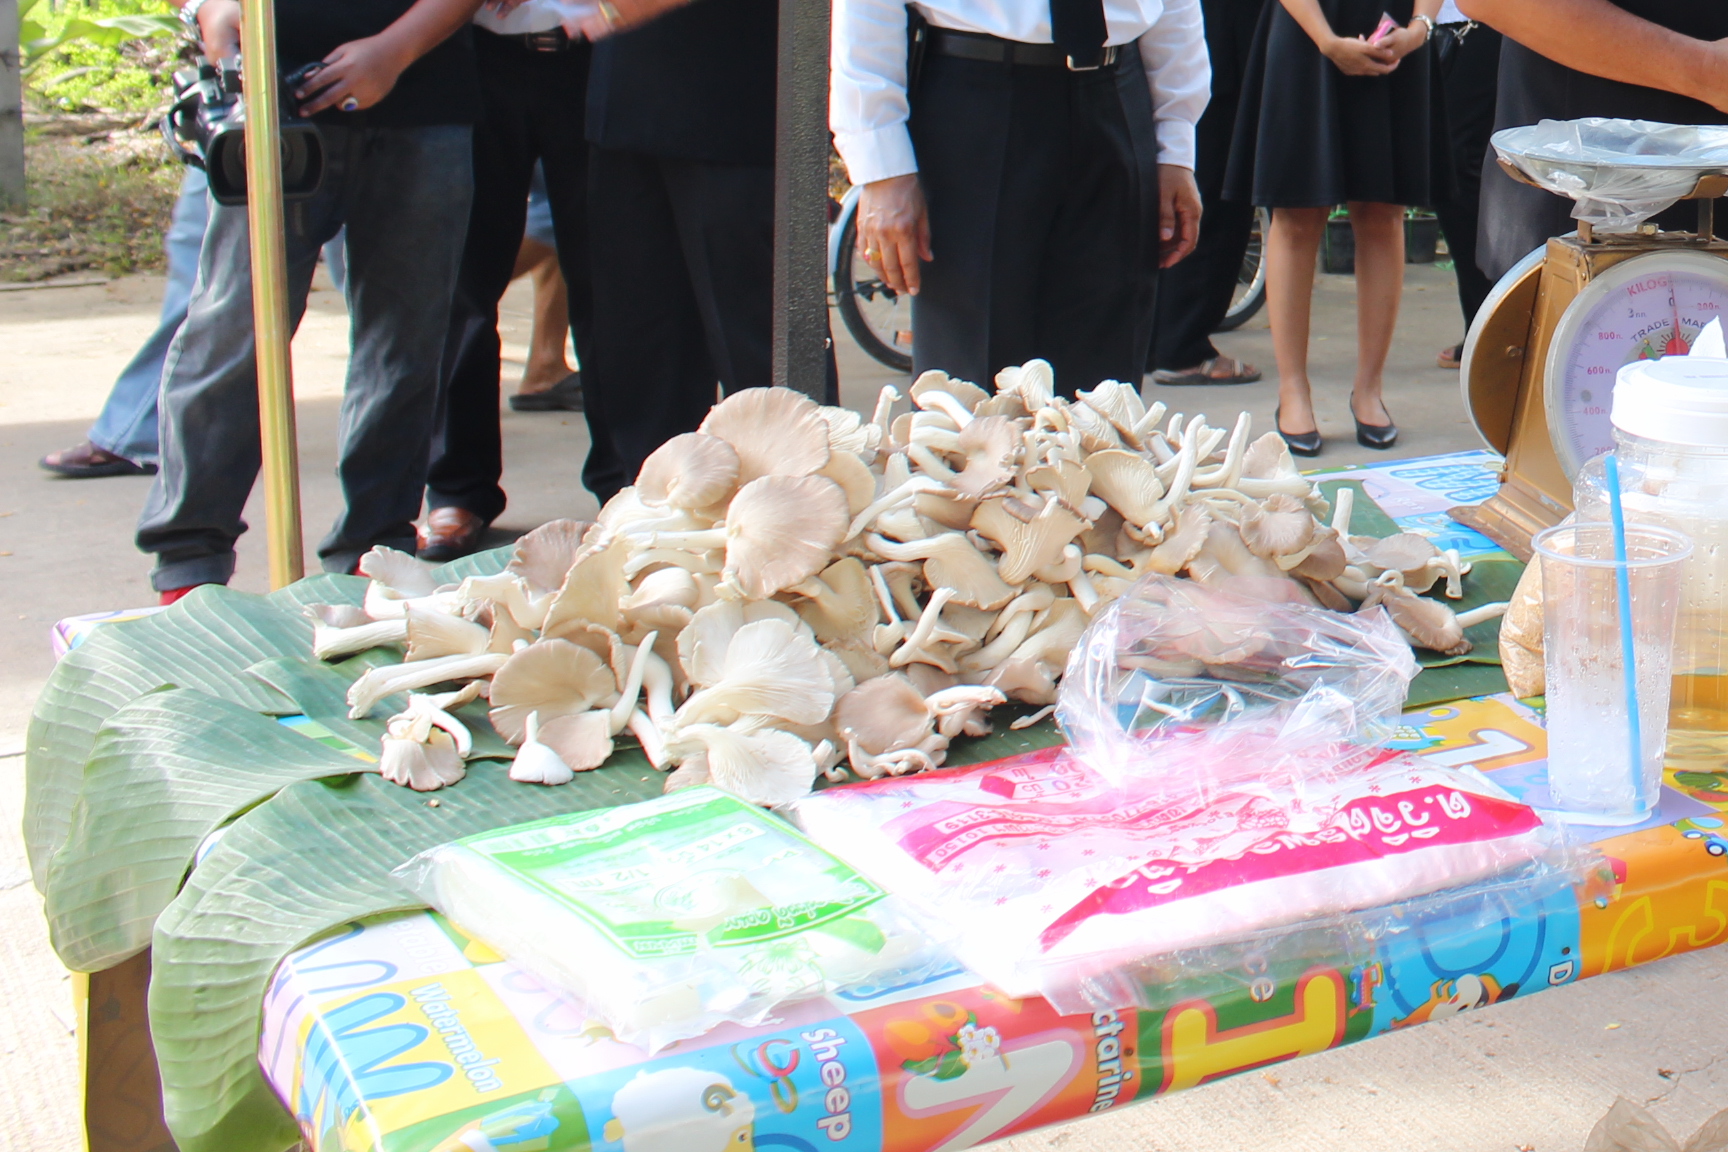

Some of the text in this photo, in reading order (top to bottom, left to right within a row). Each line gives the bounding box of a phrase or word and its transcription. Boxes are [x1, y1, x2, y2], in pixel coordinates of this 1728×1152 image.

[1630, 319, 1669, 342] TRADE
[409, 981, 503, 1093] Watermelon
[801, 1028, 852, 1142] Sheep
[1090, 1007, 1133, 1114] ctarine
